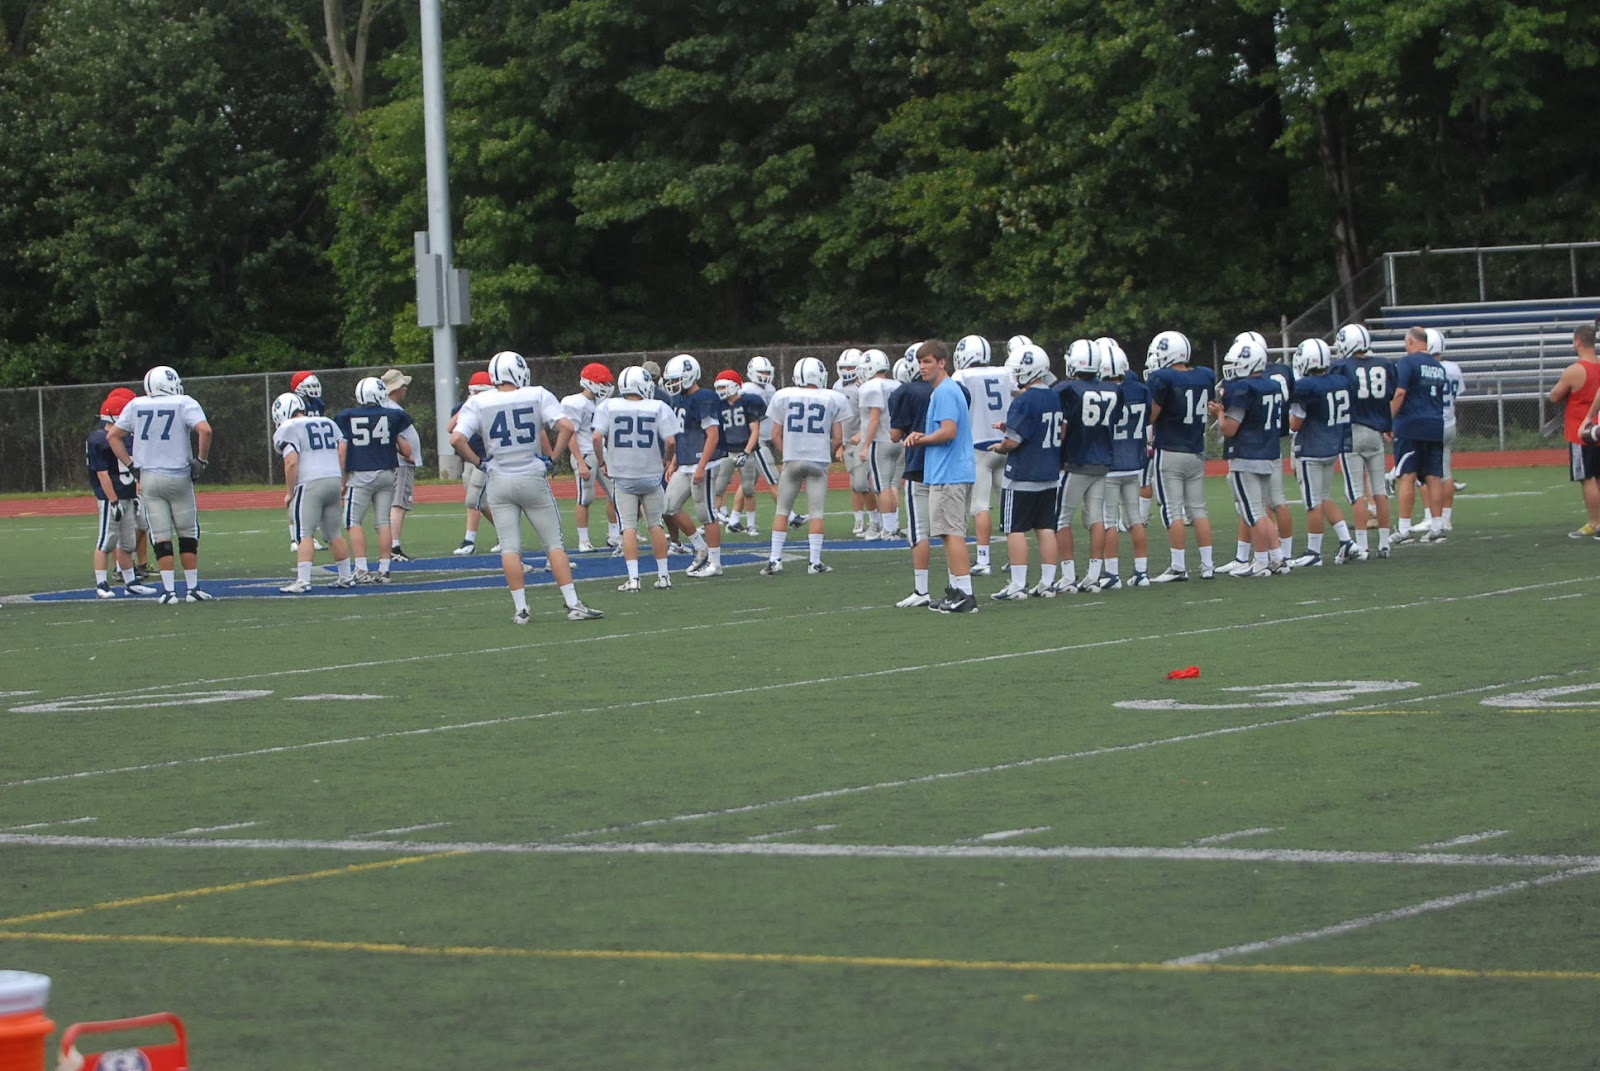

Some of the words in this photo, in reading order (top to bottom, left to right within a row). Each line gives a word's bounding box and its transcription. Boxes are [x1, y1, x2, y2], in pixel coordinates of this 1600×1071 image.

[984, 378, 1003, 411] 5
[1355, 366, 1387, 399] 18
[673, 406, 687, 434] 6
[721, 406, 746, 428] 36
[787, 401, 825, 434] 22
[1081, 390, 1117, 427] 67
[1113, 403, 1146, 440] 27
[1183, 388, 1209, 424] 14
[1326, 389, 1351, 427] 12
[137, 409, 176, 441] 77
[305, 421, 336, 450] 62
[350, 415, 391, 446] 54
[489, 407, 536, 447] 45
[614, 416, 656, 449] 25
